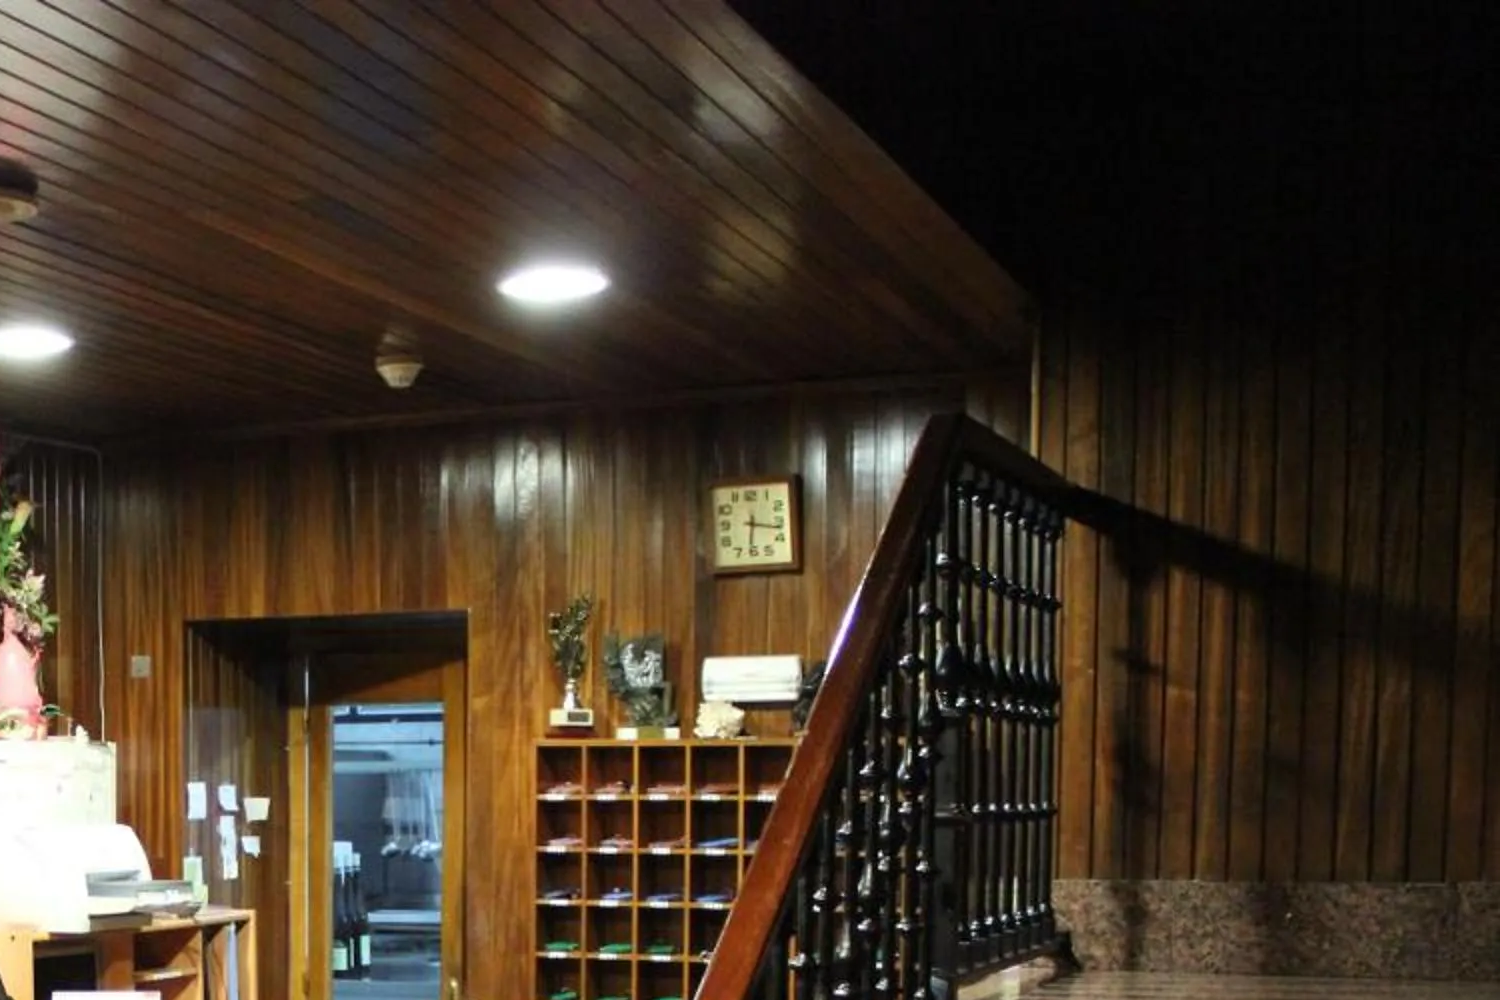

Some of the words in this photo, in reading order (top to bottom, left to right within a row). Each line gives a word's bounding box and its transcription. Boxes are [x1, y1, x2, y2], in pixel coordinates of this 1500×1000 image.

[718, 503, 733, 515] 10
[774, 499, 784, 512] 2
[720, 519, 731, 532] 9
[722, 535, 732, 548] 8
[775, 532, 785, 542] 4
[733, 547, 742, 559] 7
[749, 545, 760, 557] 6
[764, 545, 775, 556] 5
